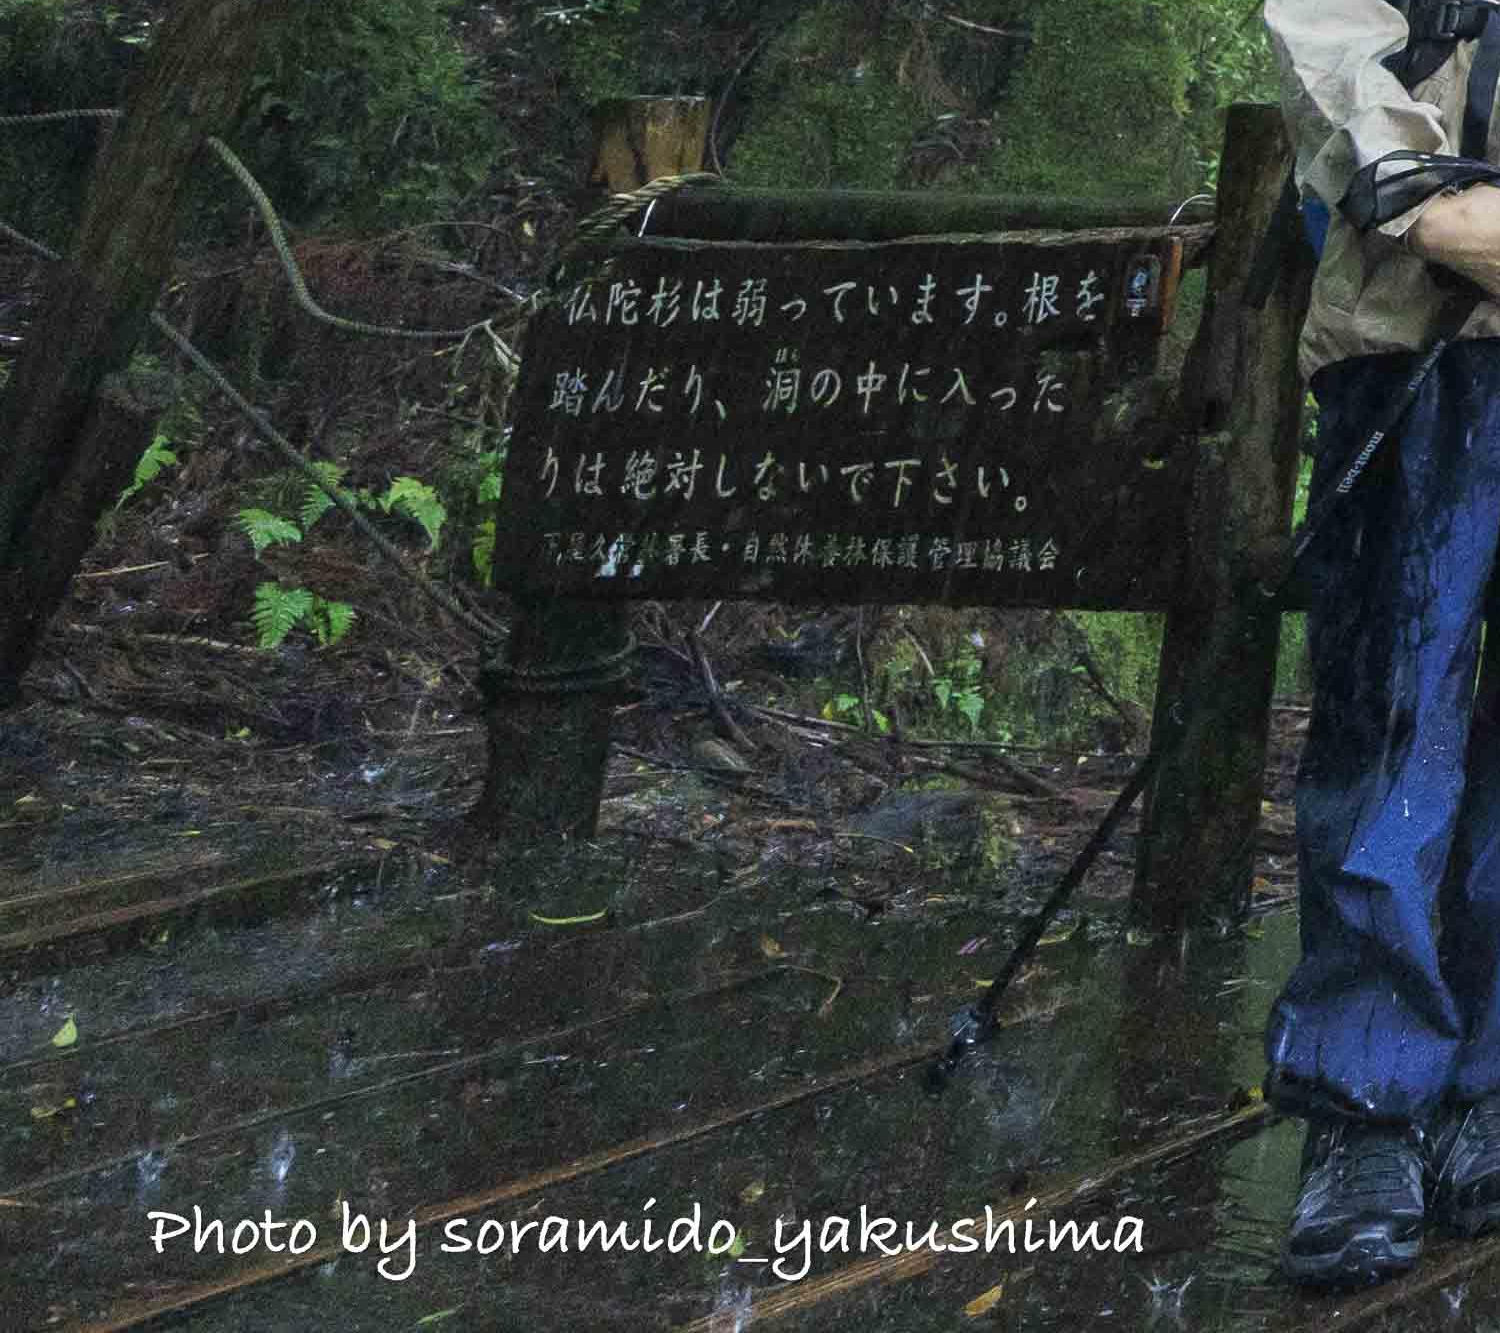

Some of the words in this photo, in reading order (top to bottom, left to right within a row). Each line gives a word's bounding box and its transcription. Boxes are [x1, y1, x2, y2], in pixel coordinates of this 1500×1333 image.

[564, 270, 1105, 328] 仏陀杉は弱っています。根を
[549, 360, 1065, 422] 踏んだり、洞の中に入った
[539, 446, 1028, 512] りは絶対しないで下さい。
